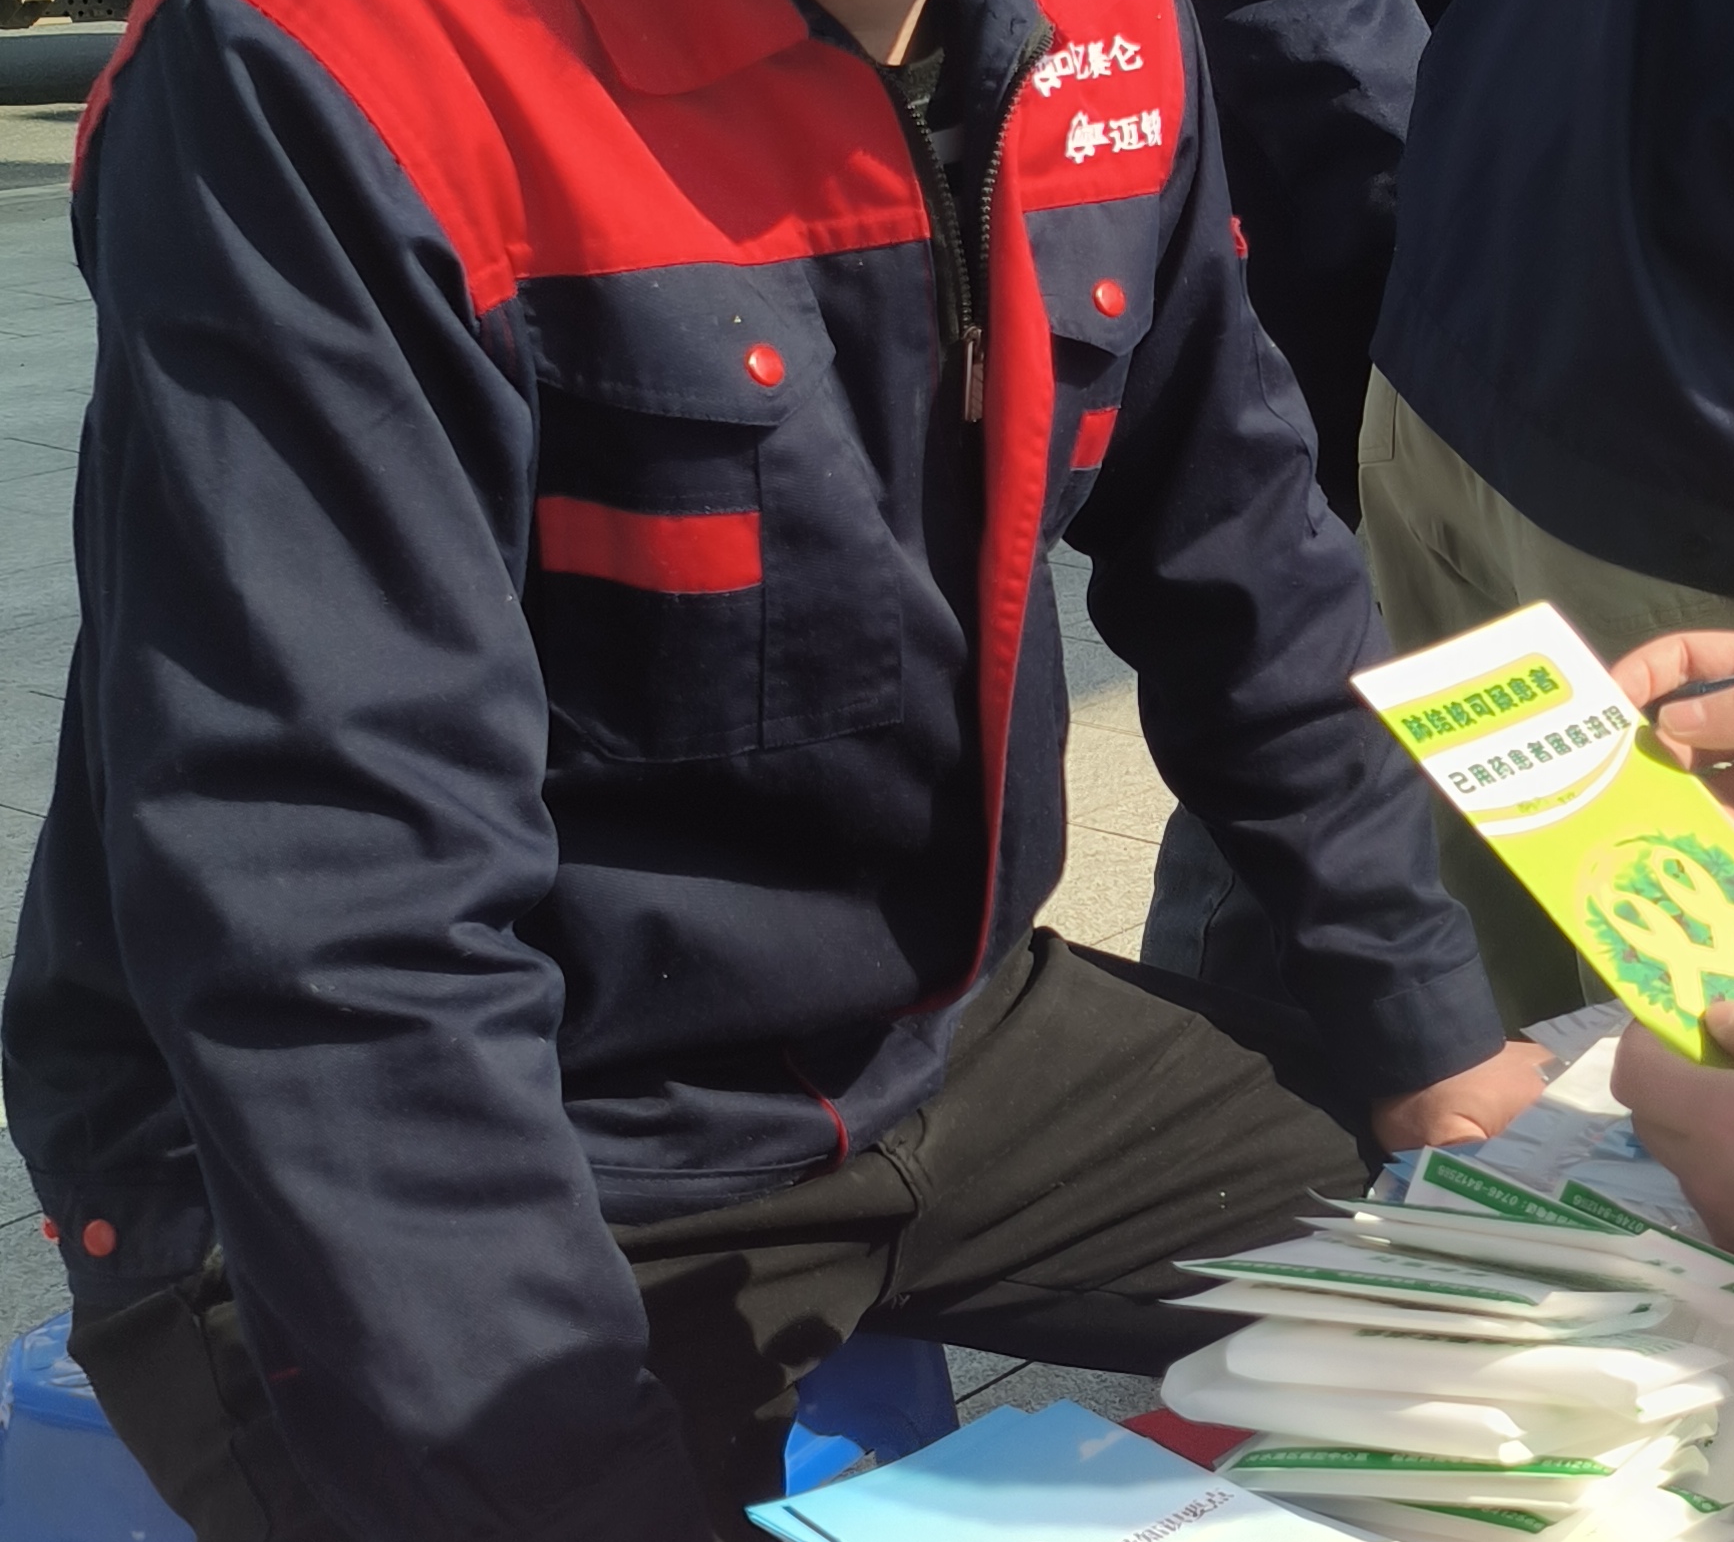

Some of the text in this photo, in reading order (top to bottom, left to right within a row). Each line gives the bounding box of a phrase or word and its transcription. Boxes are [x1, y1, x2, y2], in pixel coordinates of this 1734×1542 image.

[1401, 664, 1560, 744] 肺结核可疑患者
